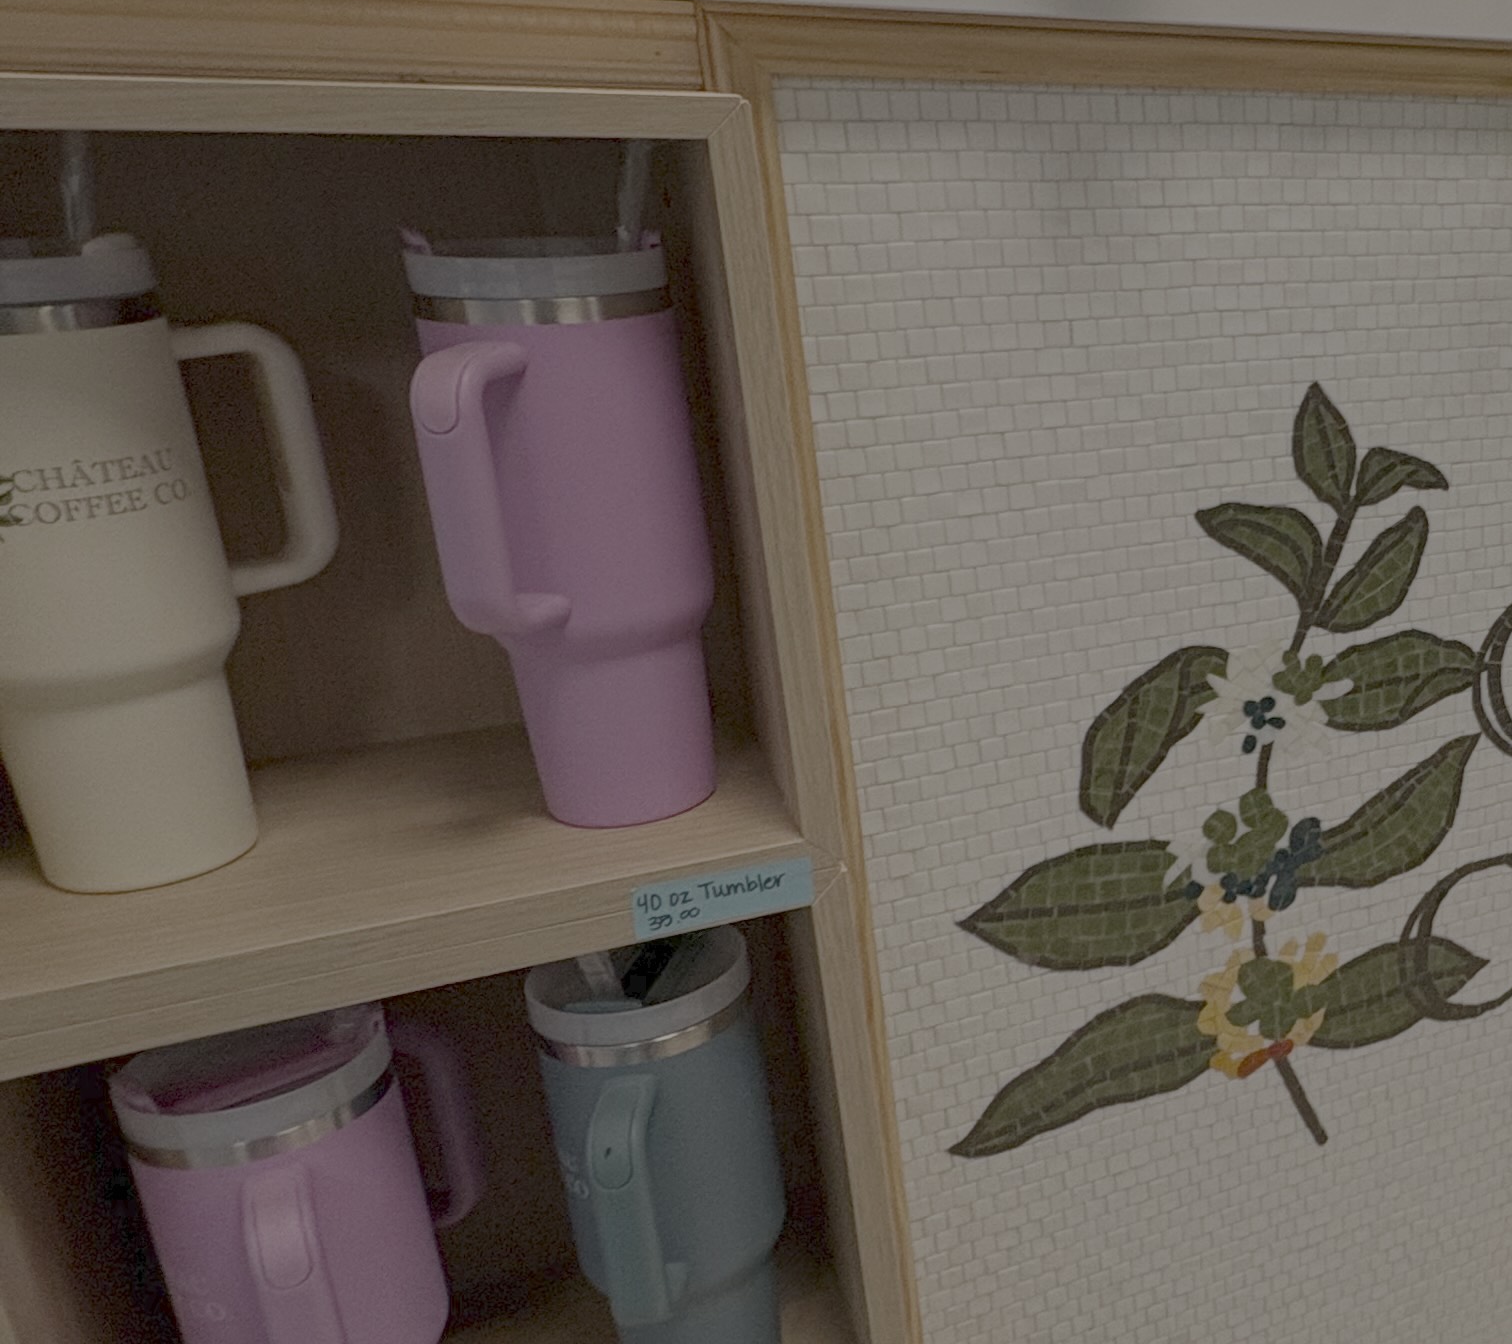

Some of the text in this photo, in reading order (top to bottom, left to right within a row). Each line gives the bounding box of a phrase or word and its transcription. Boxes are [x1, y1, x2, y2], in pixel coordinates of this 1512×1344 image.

[12, 448, 174, 494] CHÂTEAU
[8, 487, 149, 527] COFFEE
[637, 872, 786, 914] 40 oz Tumbler
